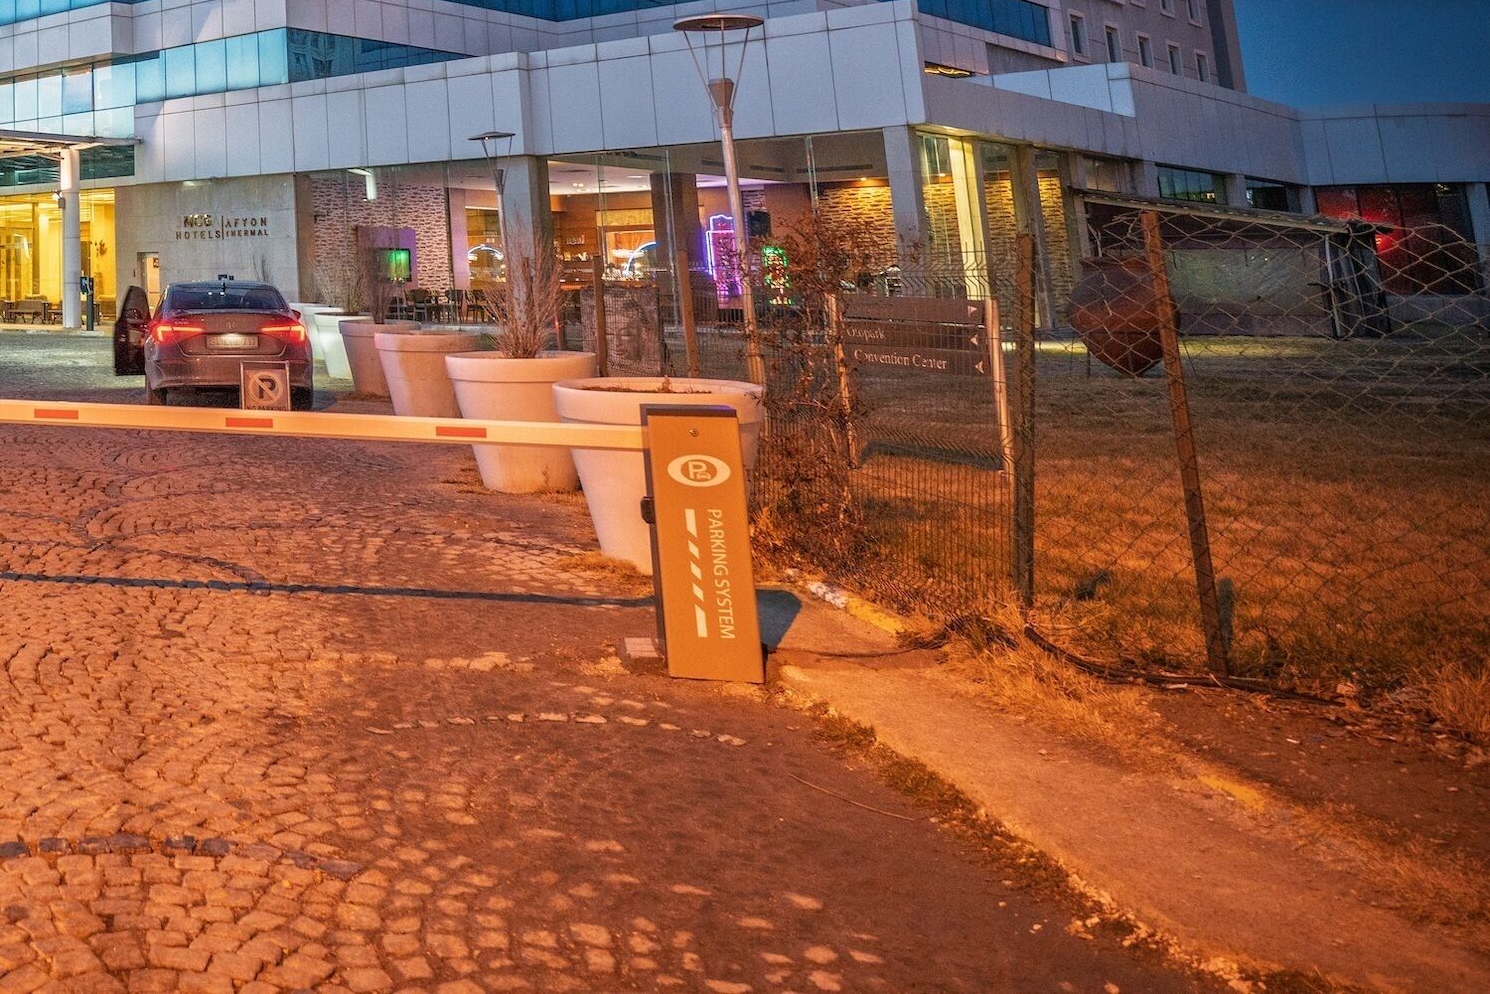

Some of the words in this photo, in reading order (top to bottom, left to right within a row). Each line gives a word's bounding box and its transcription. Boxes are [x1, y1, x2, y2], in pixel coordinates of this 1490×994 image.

[183, 213, 213, 228] MCG
[225, 217, 268, 228] AFYON
[175, 230, 221, 240] HOTELS
[225, 228, 269, 237] THERMAL
[707, 508, 729, 576] PARKING
[714, 579, 736, 639] SYSTEM
